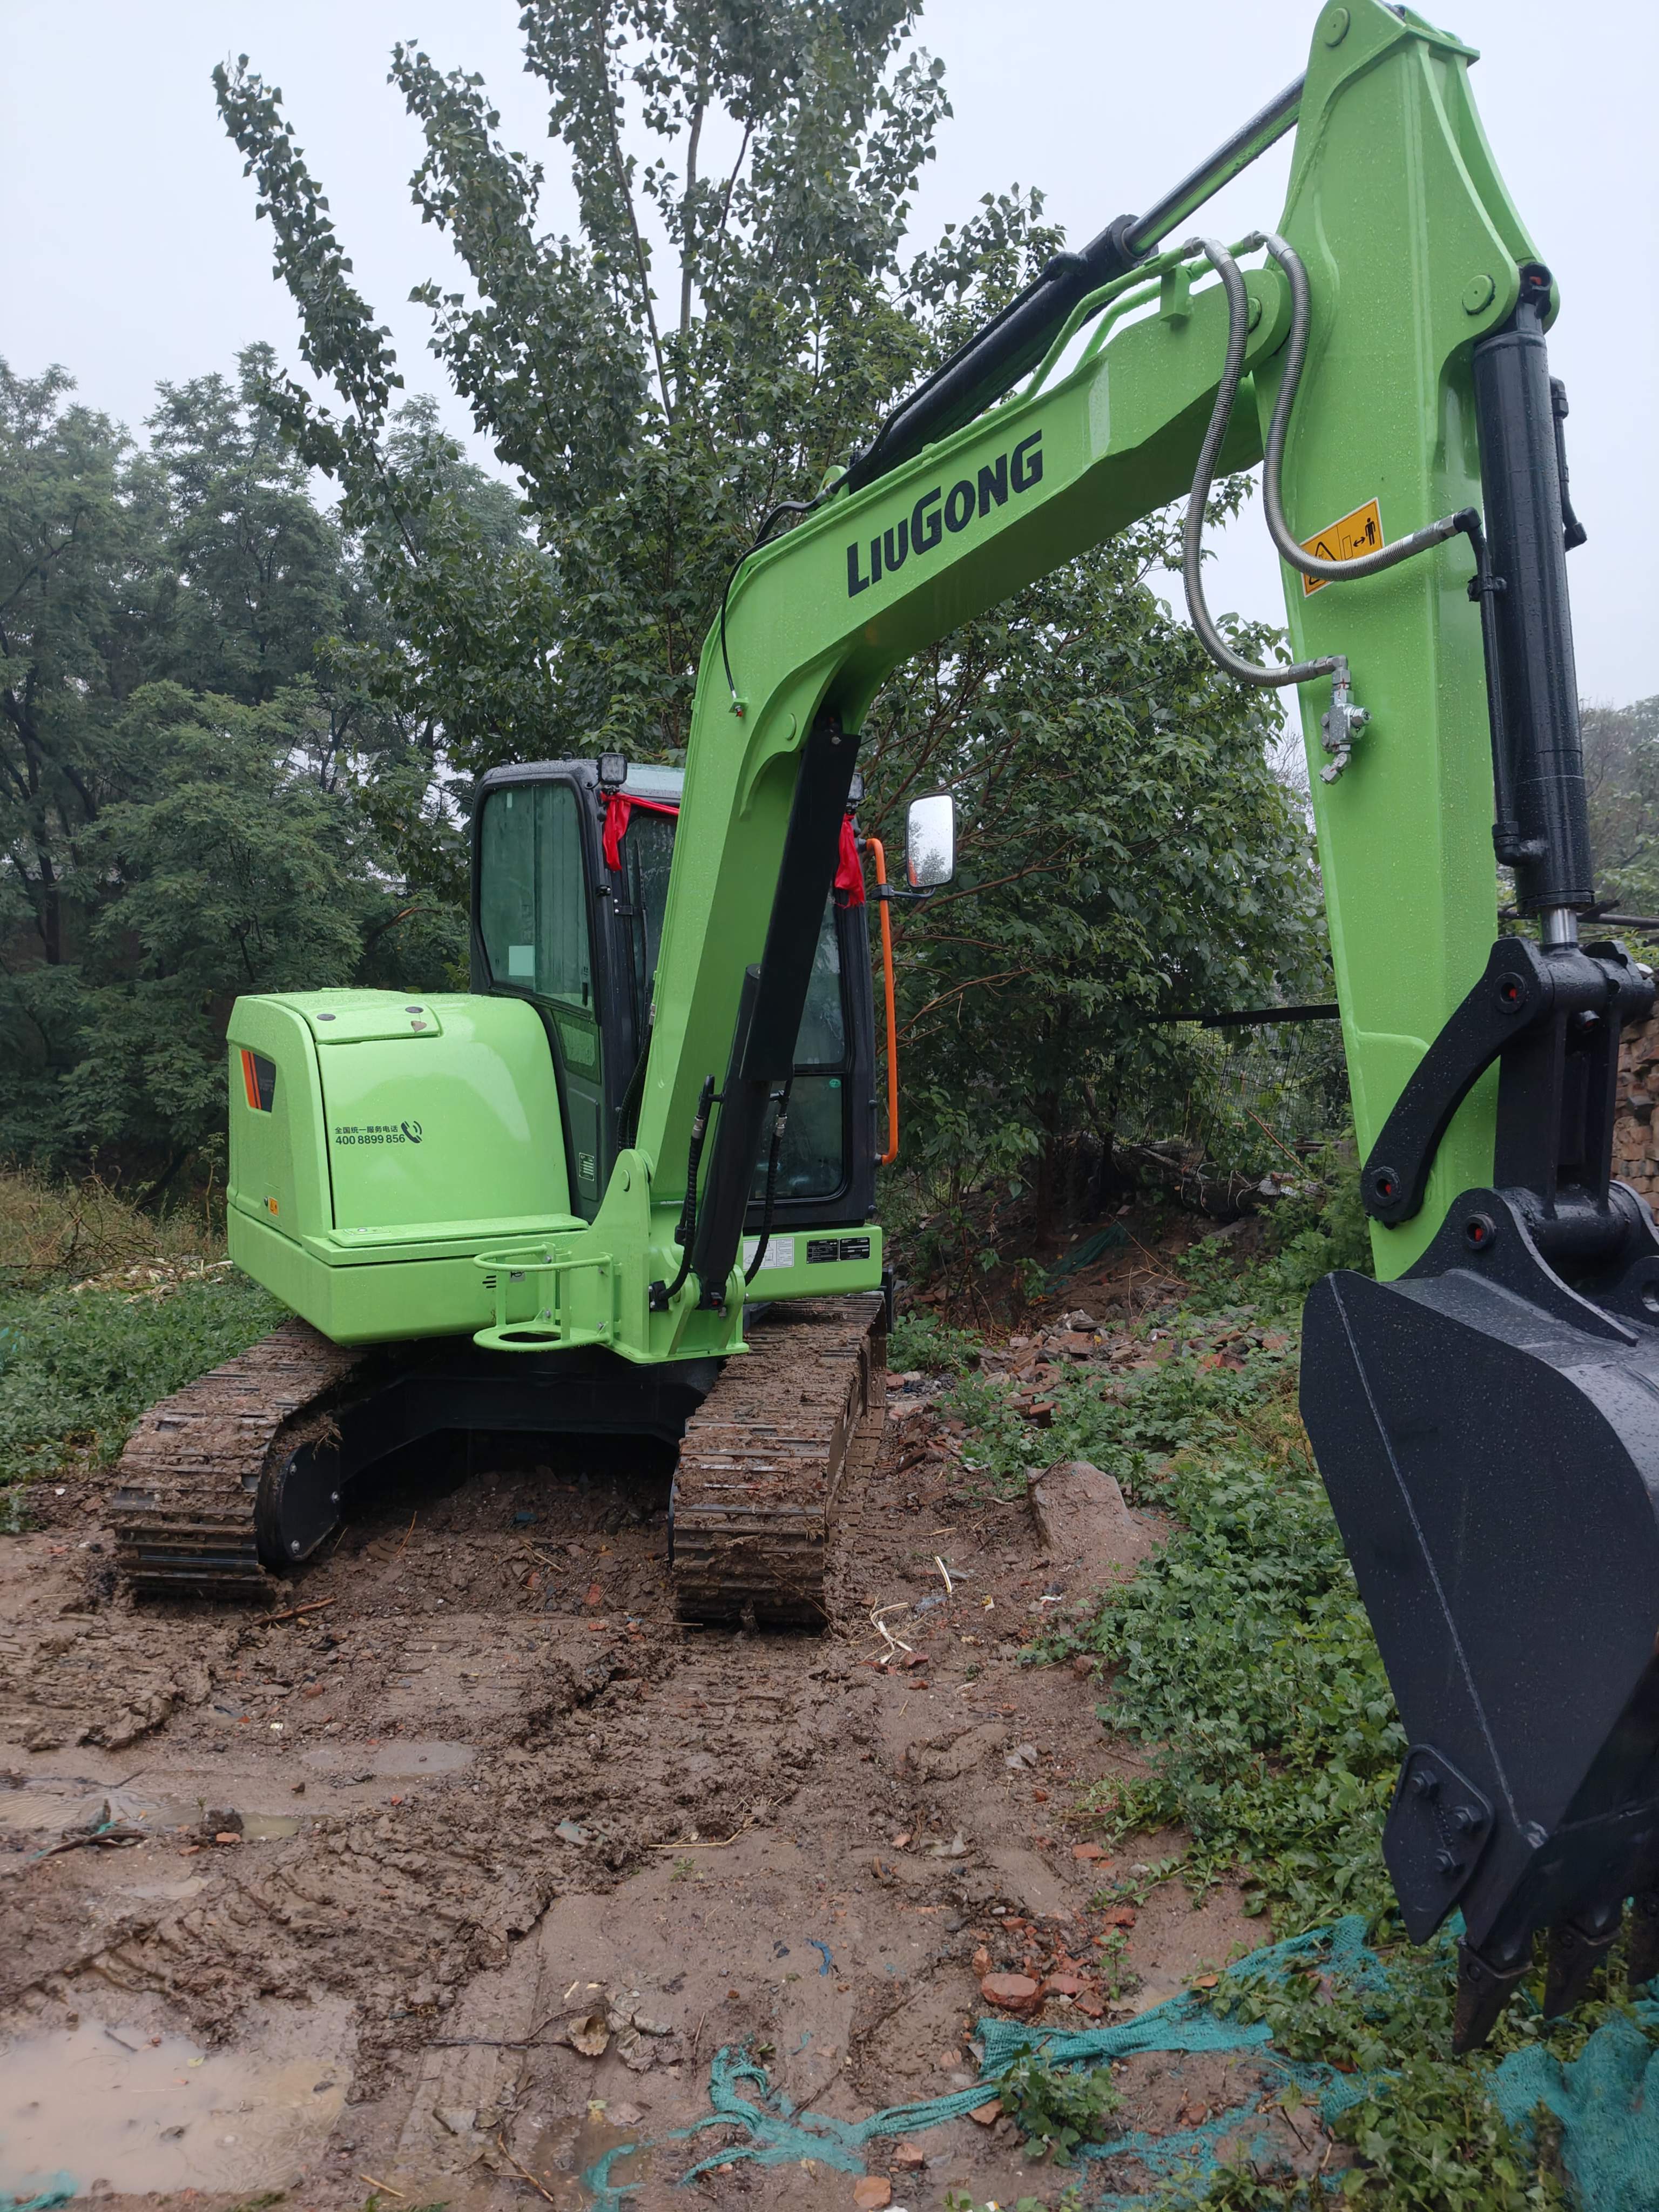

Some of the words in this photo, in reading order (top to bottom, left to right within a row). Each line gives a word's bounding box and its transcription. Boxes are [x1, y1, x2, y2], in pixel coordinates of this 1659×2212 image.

[847, 429, 1043, 598] LIUGONG
[335, 1125, 398, 1134] 全国统一服务电话
[335, 1135, 356, 1145] 400
[358, 1135, 384, 1144] 8899
[386, 1134, 406, 1143] 856
